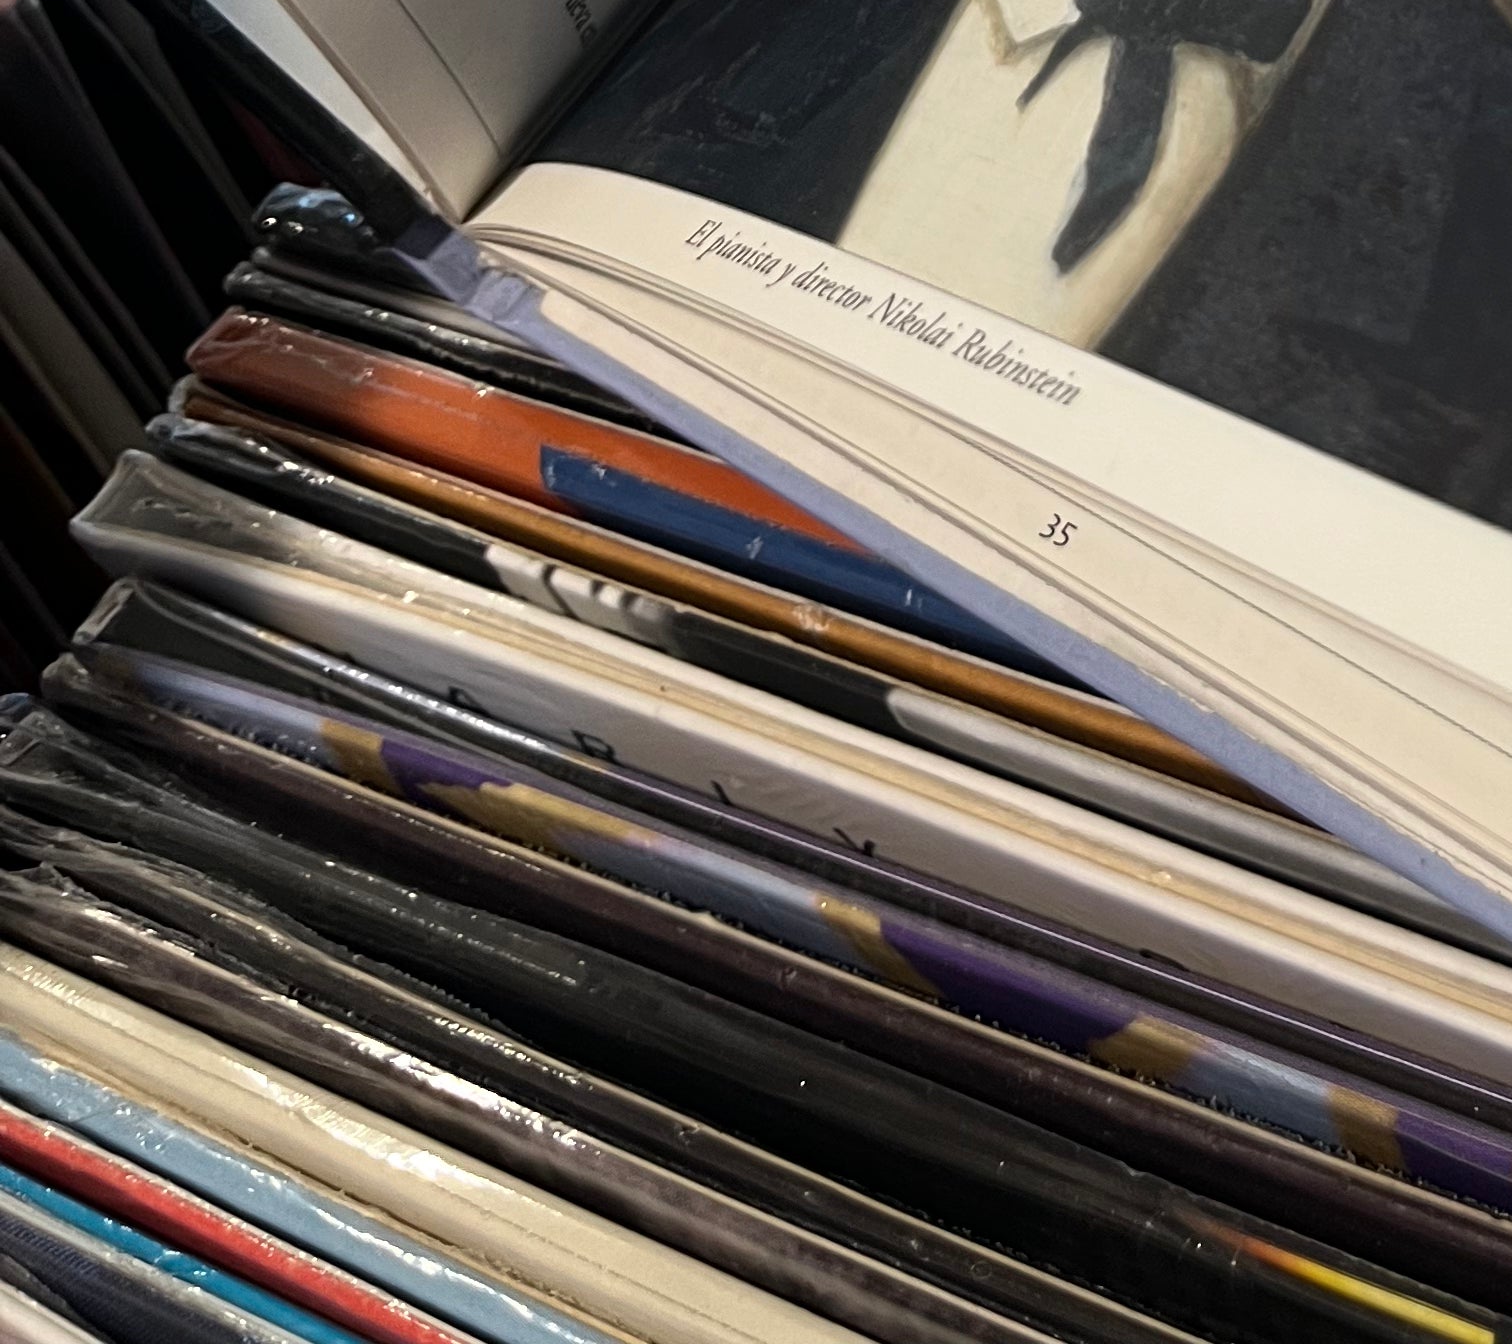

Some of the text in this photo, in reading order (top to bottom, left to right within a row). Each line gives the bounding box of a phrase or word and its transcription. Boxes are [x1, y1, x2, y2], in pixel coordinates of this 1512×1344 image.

[684, 218, 1083, 407] El pianista y director Nikolai Rubinstein
[1038, 512, 1078, 547] 35
